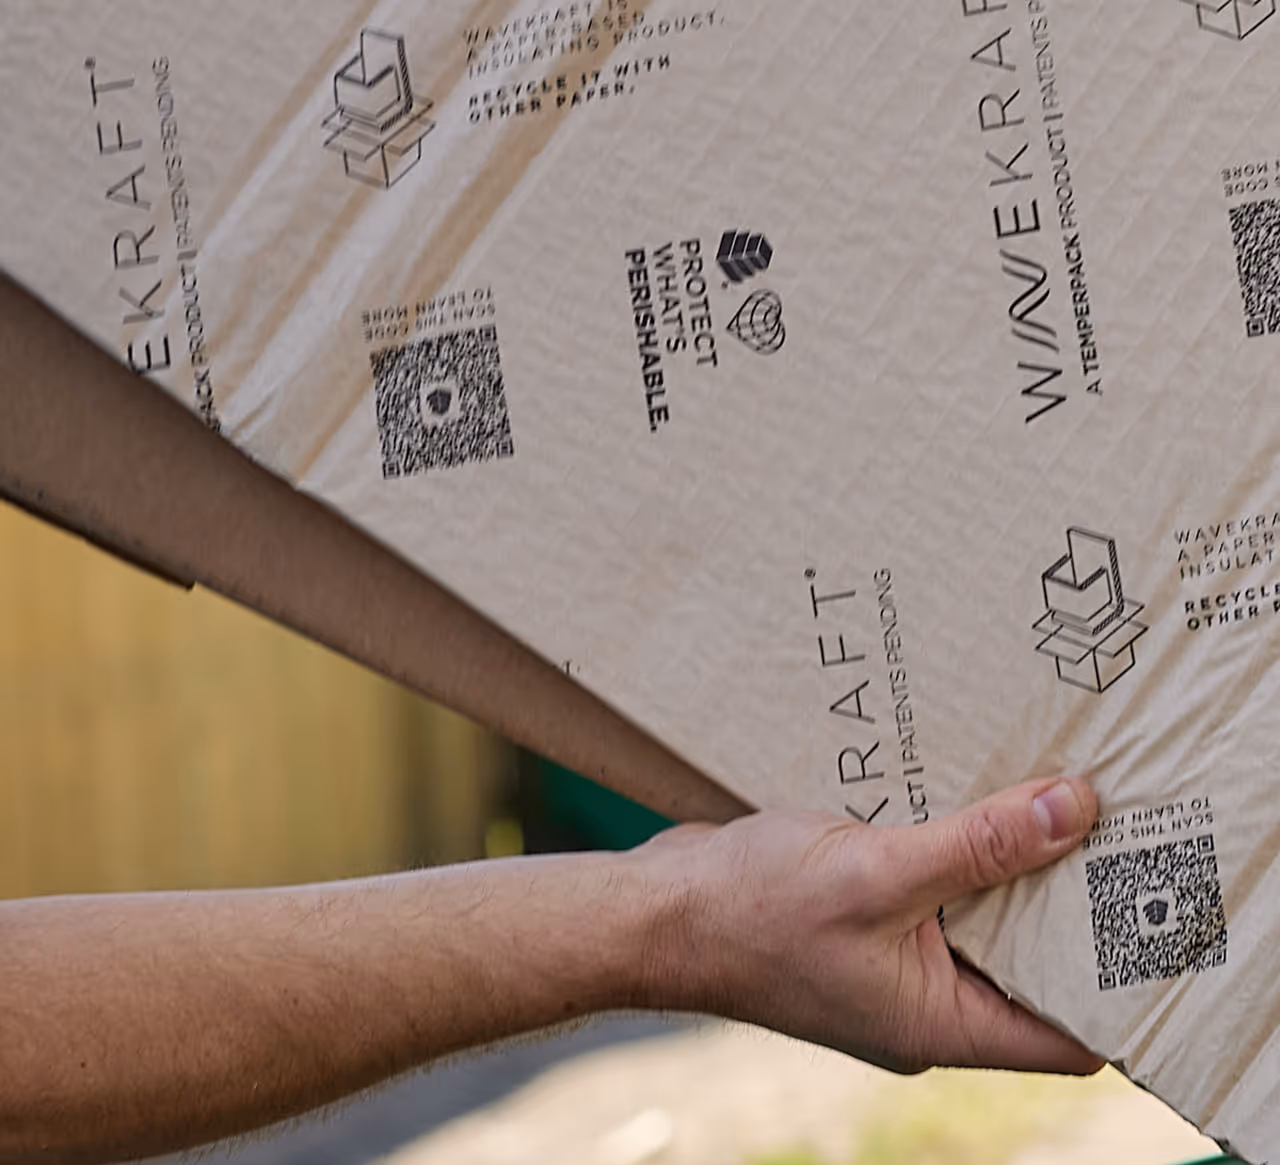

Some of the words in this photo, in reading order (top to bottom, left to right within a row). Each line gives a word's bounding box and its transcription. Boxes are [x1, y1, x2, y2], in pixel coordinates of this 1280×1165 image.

[1031, 16, 1060, 111] PATENTS
[469, 73, 567, 109] RECYCLE
[581, 71, 600, 87] IT
[613, 53, 671, 79] WITH
[469, 98, 542, 124] OTHER
[1047, 128, 1077, 231] PRODUCT
[1220, 161, 1268, 183] MORE
[1223, 177, 1268, 198] CODE
[680, 238, 718, 369] PROTECT
[624, 248, 670, 434] PERISHABLE.
[1086, 378, 1104, 396] A
[1177, 549, 1190, 563] A
[873, 566, 903, 666] PENDING
[1187, 604, 1261, 632] OTHER
[889, 669, 919, 762] PATENTS
[1132, 802, 1184, 825] LEARN
[1191, 795, 1211, 811] TO
[1091, 814, 1125, 833] MOR
[1130, 823, 1166, 840] THIS
[1171, 811, 1214, 832] SCAN
